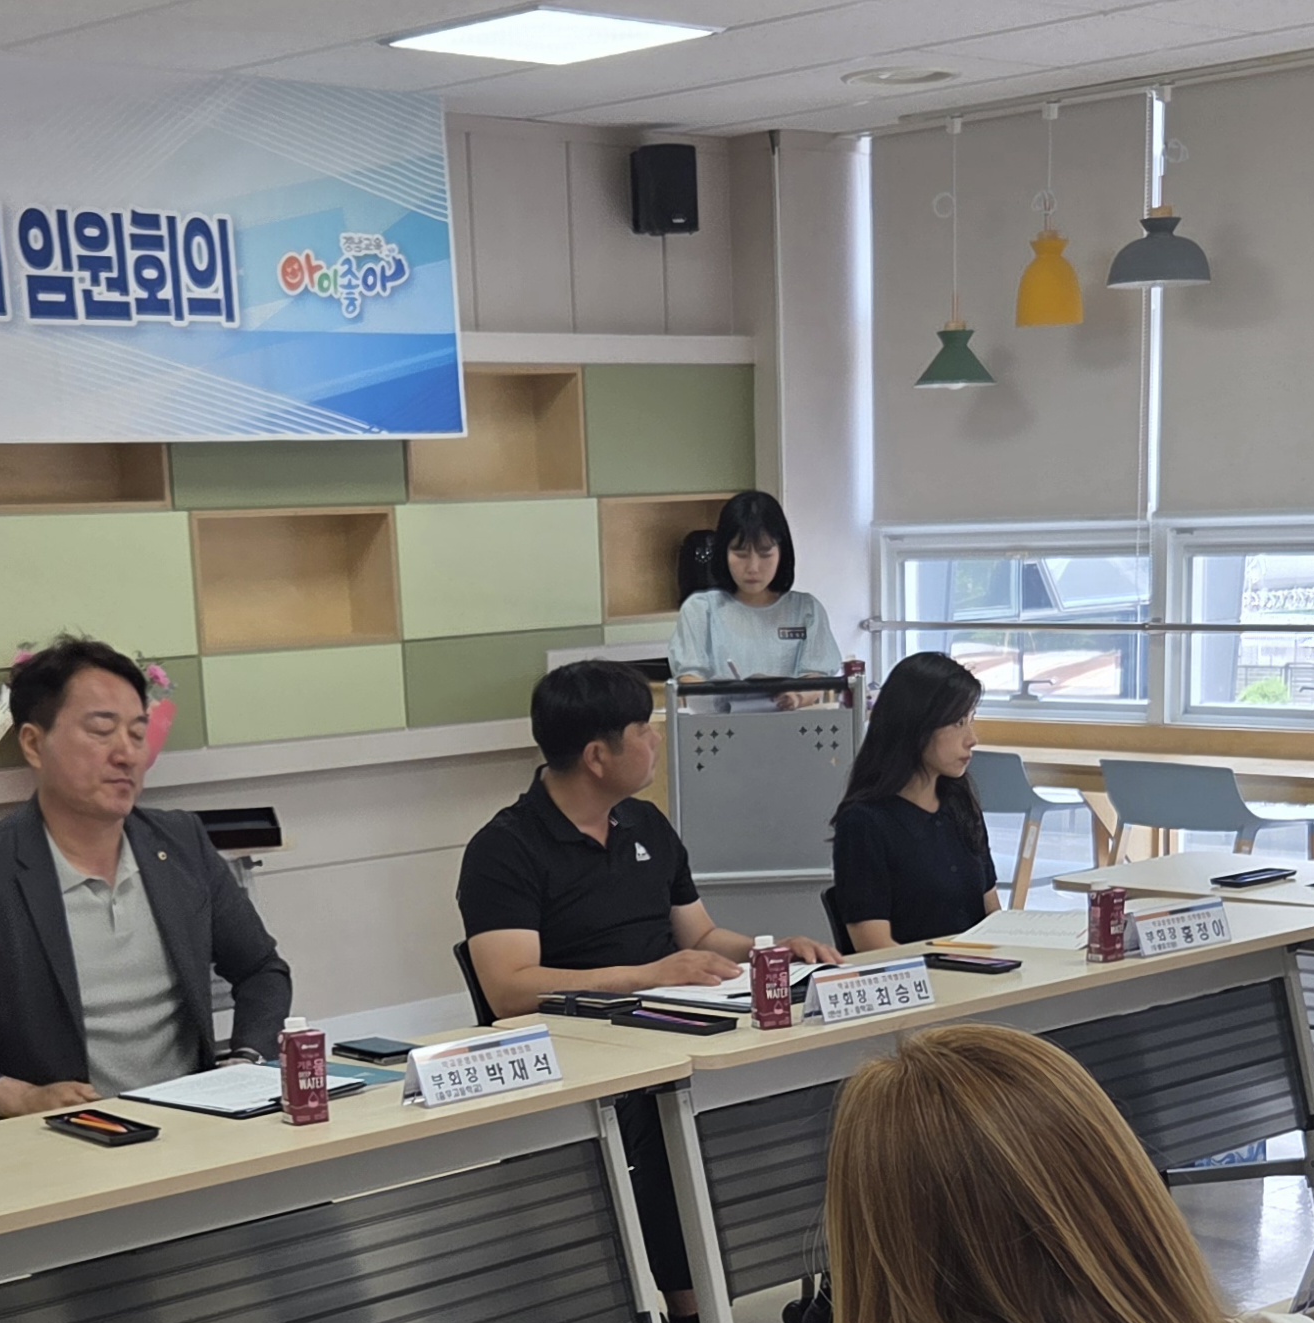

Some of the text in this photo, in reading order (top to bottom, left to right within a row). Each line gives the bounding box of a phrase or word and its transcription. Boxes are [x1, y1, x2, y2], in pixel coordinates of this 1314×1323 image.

[18, 206, 236, 325] 임원회의
[281, 252, 406, 315] 아이좋아
[1145, 918, 1225, 944] 부회장 홍정아
[828, 979, 930, 1008] 부회장 최승빈
[298, 1076, 325, 1091] WATER
[431, 1053, 552, 1089] 부회장 박재석
